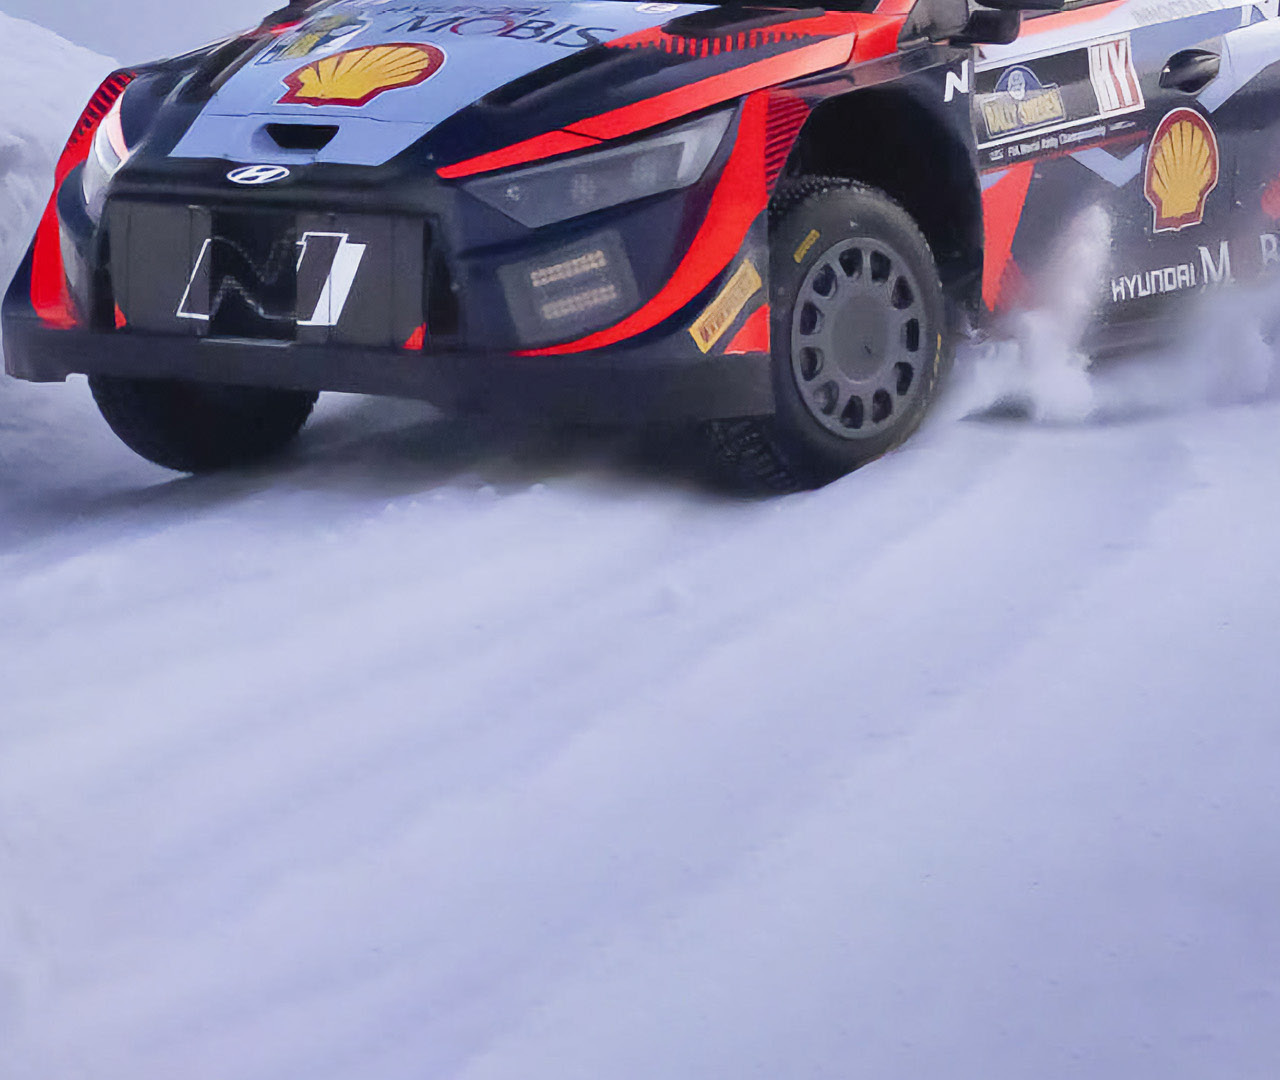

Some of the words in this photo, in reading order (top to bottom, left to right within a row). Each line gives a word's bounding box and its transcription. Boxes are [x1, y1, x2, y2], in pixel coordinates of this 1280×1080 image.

[384, 14, 617, 48] MOBIS
[943, 58, 970, 103] N
[1111, 262, 1197, 303] HYUNDAI
